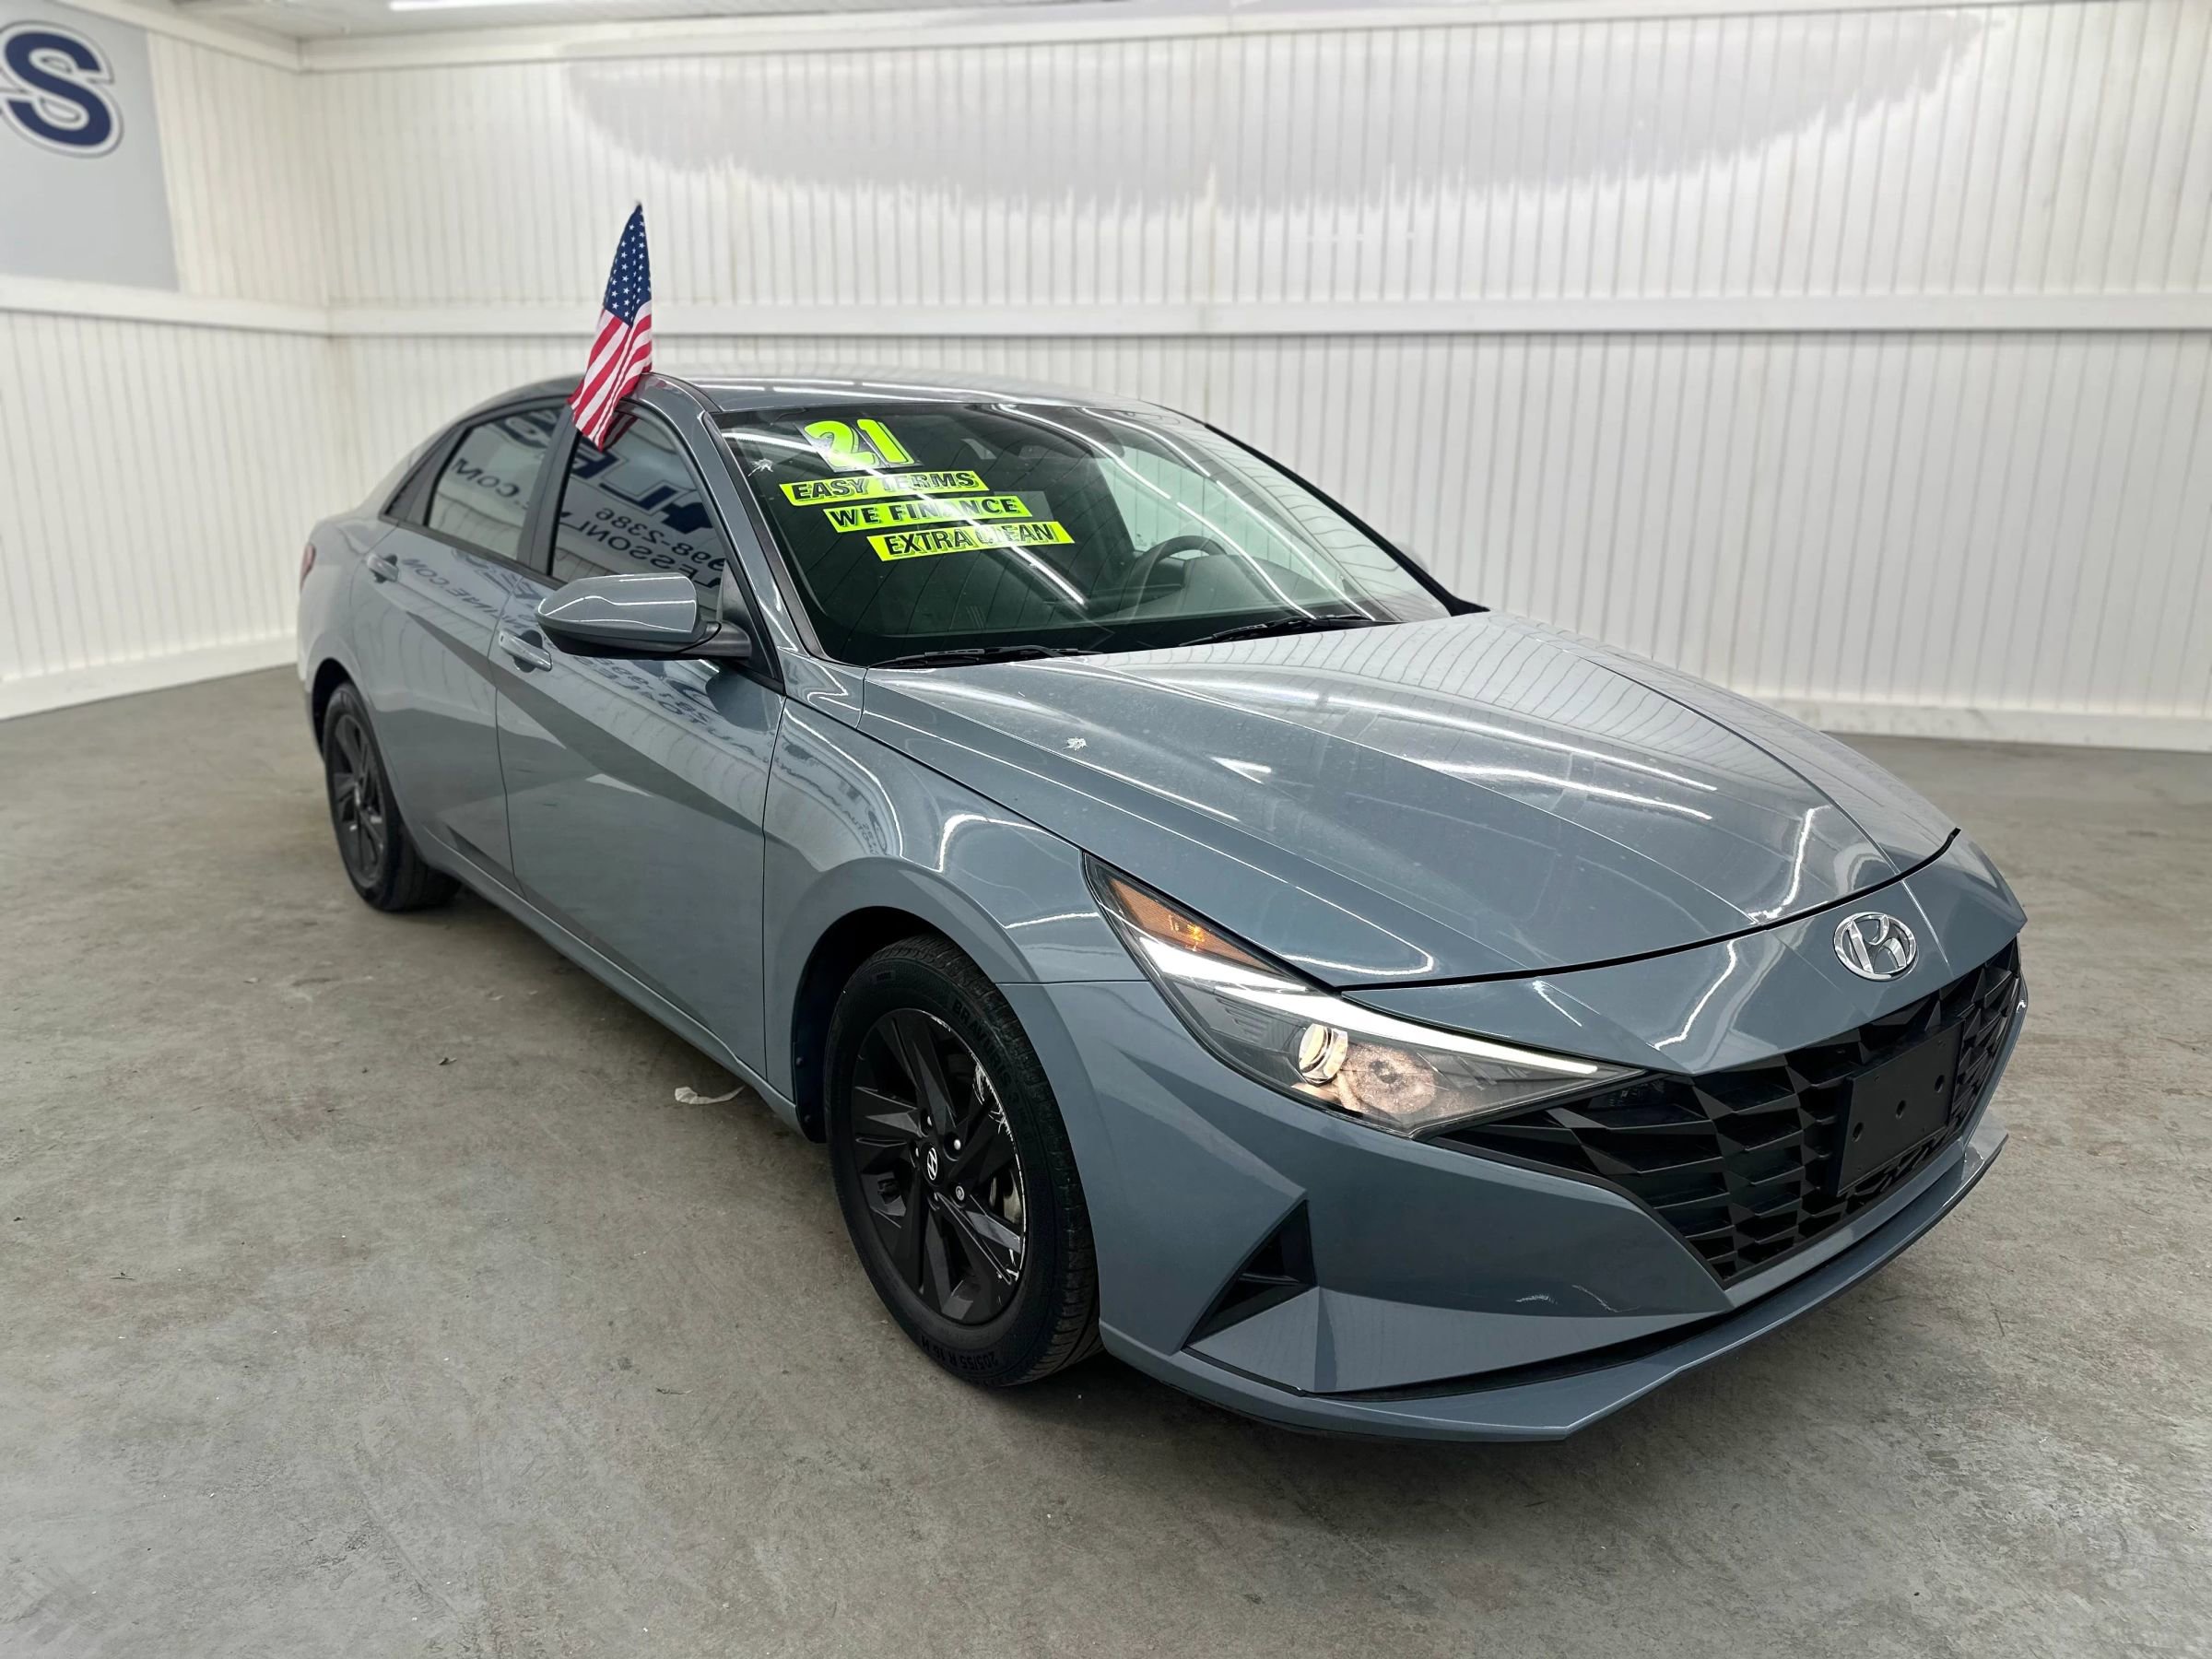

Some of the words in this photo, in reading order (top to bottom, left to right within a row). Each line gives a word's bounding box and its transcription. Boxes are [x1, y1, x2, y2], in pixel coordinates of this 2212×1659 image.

[805, 418, 912, 467] 21
[792, 478, 867, 500] EASY
[881, 472, 979, 492] TERMS
[830, 508, 880, 526] WE
[888, 499, 1018, 521] FINANCE
[884, 529, 973, 555] EXTRA
